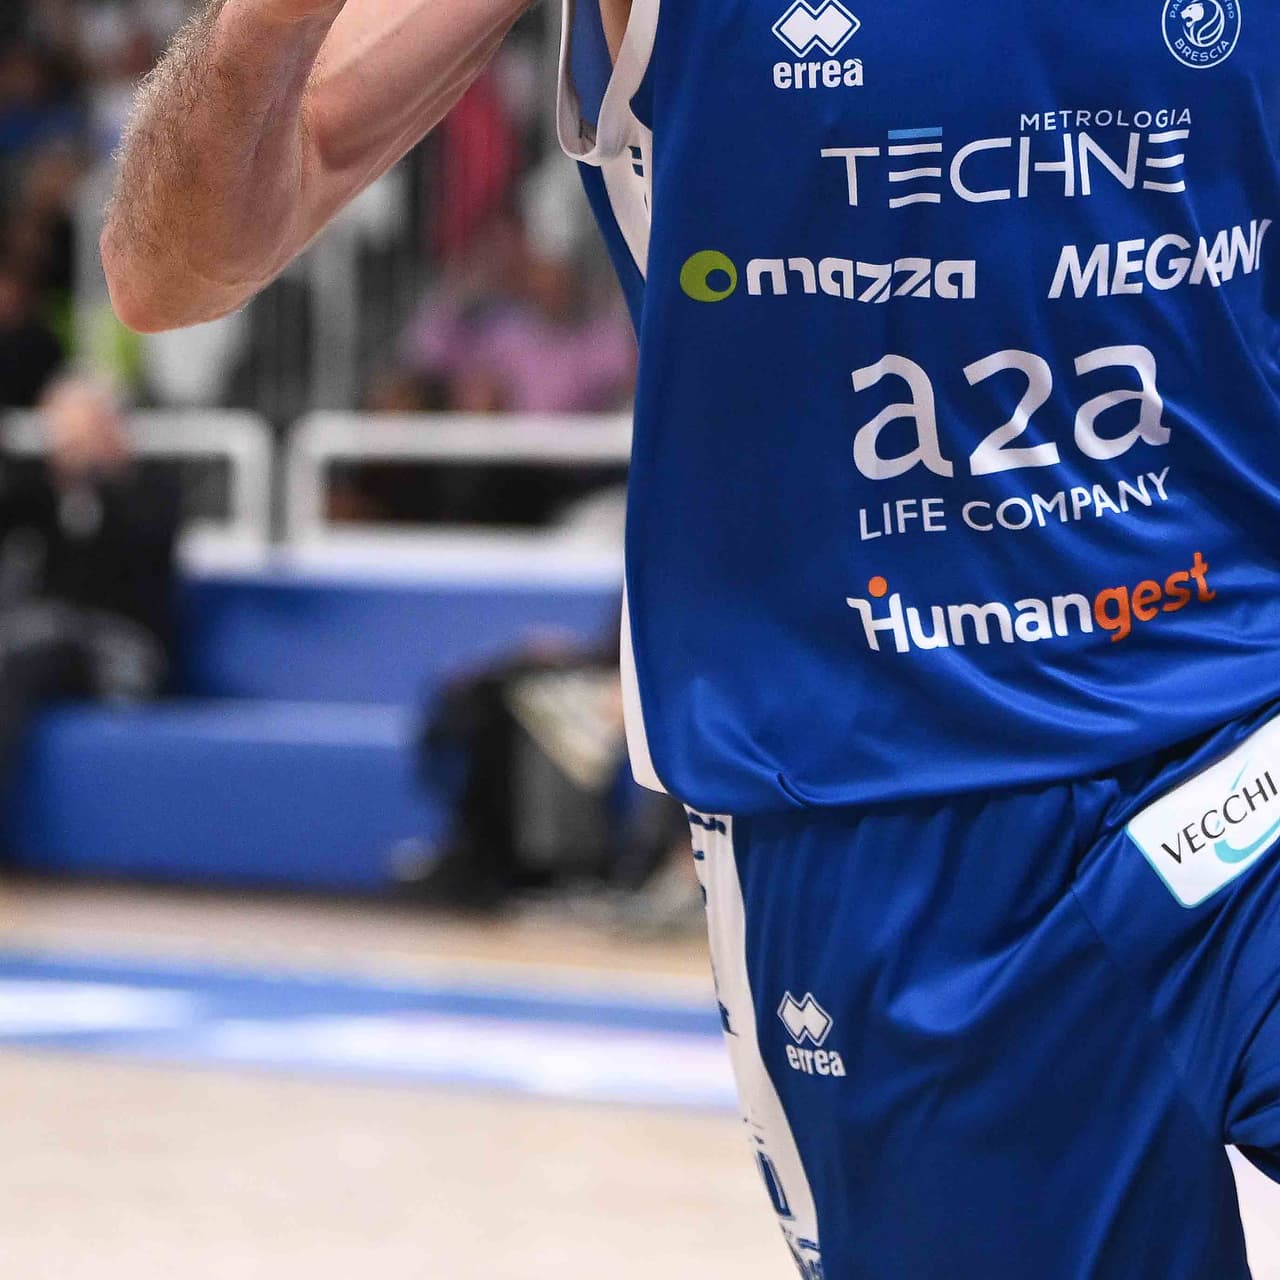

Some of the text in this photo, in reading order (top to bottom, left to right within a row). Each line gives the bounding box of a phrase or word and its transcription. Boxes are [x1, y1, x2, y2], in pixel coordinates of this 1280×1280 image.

[1174, 38, 1230, 62] BRESCIA
[1020, 108, 1192, 131] METROLOGIA
[820, 127, 1191, 208] TECHNE
[746, 257, 976, 304] mazza
[851, 345, 1171, 480] a2a
[859, 467, 1170, 541] LIFE COMPANY
[846, 552, 1217, 653] Humangest
[1161, 771, 1278, 864] VECCHI
